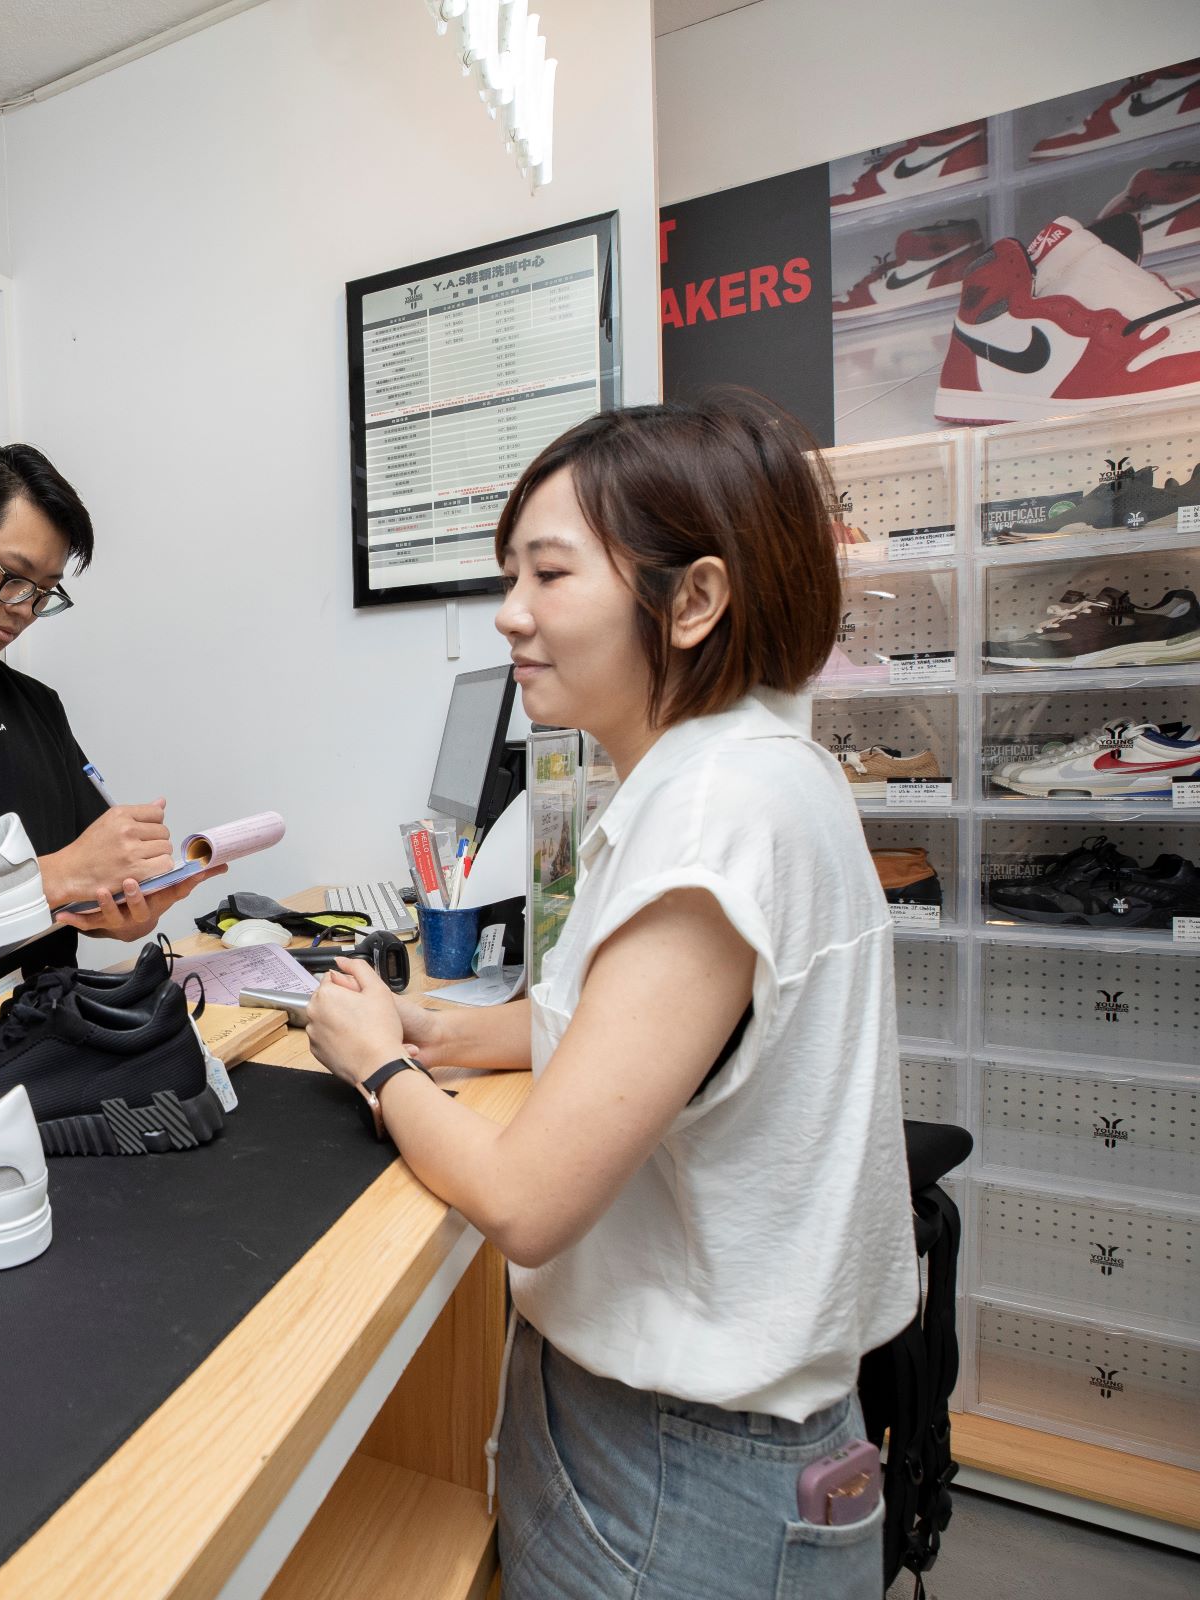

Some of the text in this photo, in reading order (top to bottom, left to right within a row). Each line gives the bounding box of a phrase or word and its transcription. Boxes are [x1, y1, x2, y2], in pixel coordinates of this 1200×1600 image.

[1046, 228, 1065, 247] AIR
[661, 257, 812, 329] AKERS
[988, 506, 1046, 523] ERTIFICATE
[982, 745, 1039, 756] ERTIFICATE
[1095, 1001, 1129, 1009] YOUNG
[1094, 1127, 1128, 1137] YOUNG
[1090, 1254, 1124, 1264] YOUNG
[1090, 1376, 1124, 1388] YOUNG
